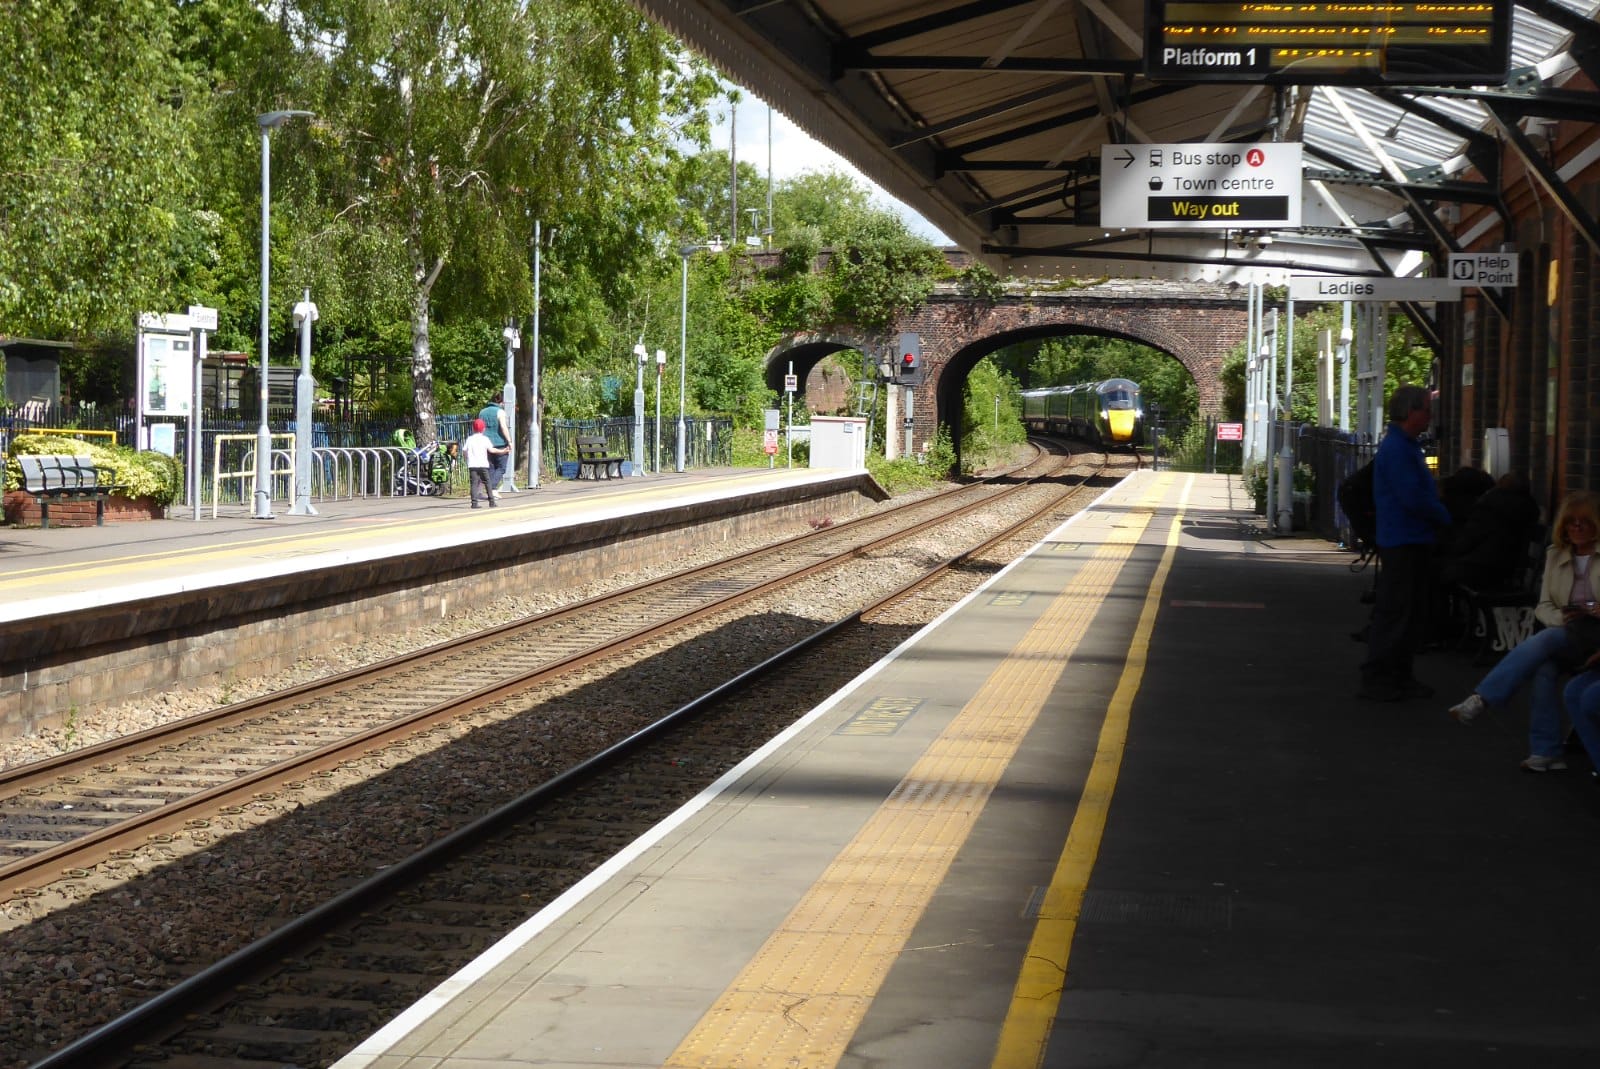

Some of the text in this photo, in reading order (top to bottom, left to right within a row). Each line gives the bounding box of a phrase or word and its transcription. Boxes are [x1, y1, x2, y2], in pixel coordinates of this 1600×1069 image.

[1163, 47, 1241, 66] Platform
[1246, 47, 1256, 66] 1
[1172, 151, 1261, 168] Bus stop A
[1172, 176, 1274, 191] Town centre
[1172, 201, 1240, 219] Way out
[1478, 256, 1510, 270] Help
[1478, 271, 1513, 284] Point
[1318, 281, 1374, 295] Ladies
